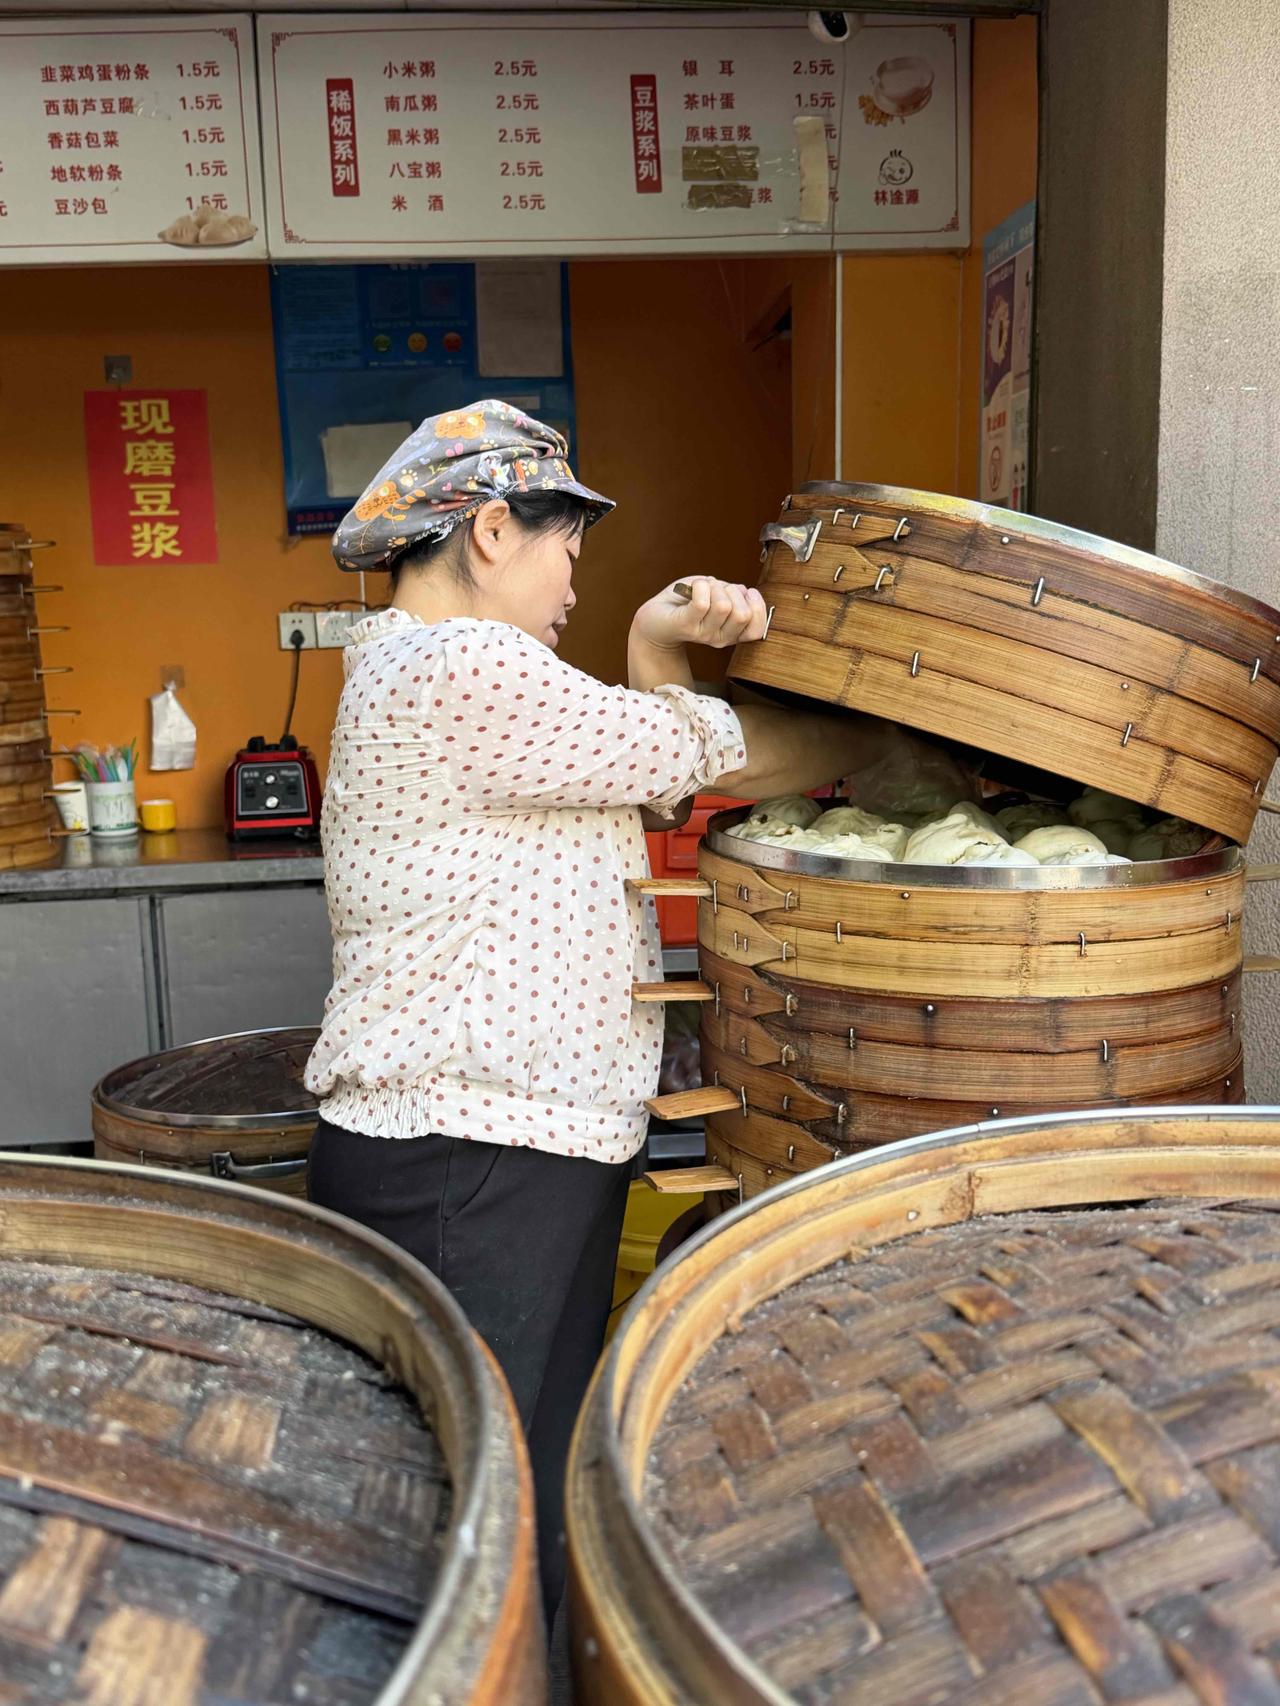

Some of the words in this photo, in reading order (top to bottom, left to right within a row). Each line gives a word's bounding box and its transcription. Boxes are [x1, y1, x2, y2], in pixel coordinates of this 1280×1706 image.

[40, 63, 150, 83] 韭菜鸡蛋粉条
[176, 61, 221, 78] 1.5元
[383, 61, 436, 79] 小米粥
[494, 60, 538, 77] 2.5元
[792, 59, 836, 76] 2.5元
[43, 97, 135, 116] 西葫芦豆腐
[179, 94, 223, 112] 1.5元
[384, 95, 438, 113] 南瓜粥
[496, 94, 540, 111] 2.5元
[683, 93, 736, 111] 茶叶蛋
[795, 92, 836, 109] 1.5元
[47, 131, 120, 150] 香菇包菜
[182, 127, 226, 144] 1.5元
[330, 91, 355, 185] 稀饭系列
[387, 128, 440, 146] 黑米粥
[498, 128, 542, 144] 2.5元
[635, 87, 657, 182] 豆浆系列
[685, 125, 752, 143] 原味豆浆
[50, 164, 123, 183] 地软粉条
[185, 160, 228, 177] 1.5元
[389, 162, 442, 179] 八宝粥
[500, 161, 544, 178] 2.5元
[54, 197, 108, 216] 豆沙包
[502, 194, 546, 211] 2.5元
[121, 400, 183, 560] 现磨豆浆
